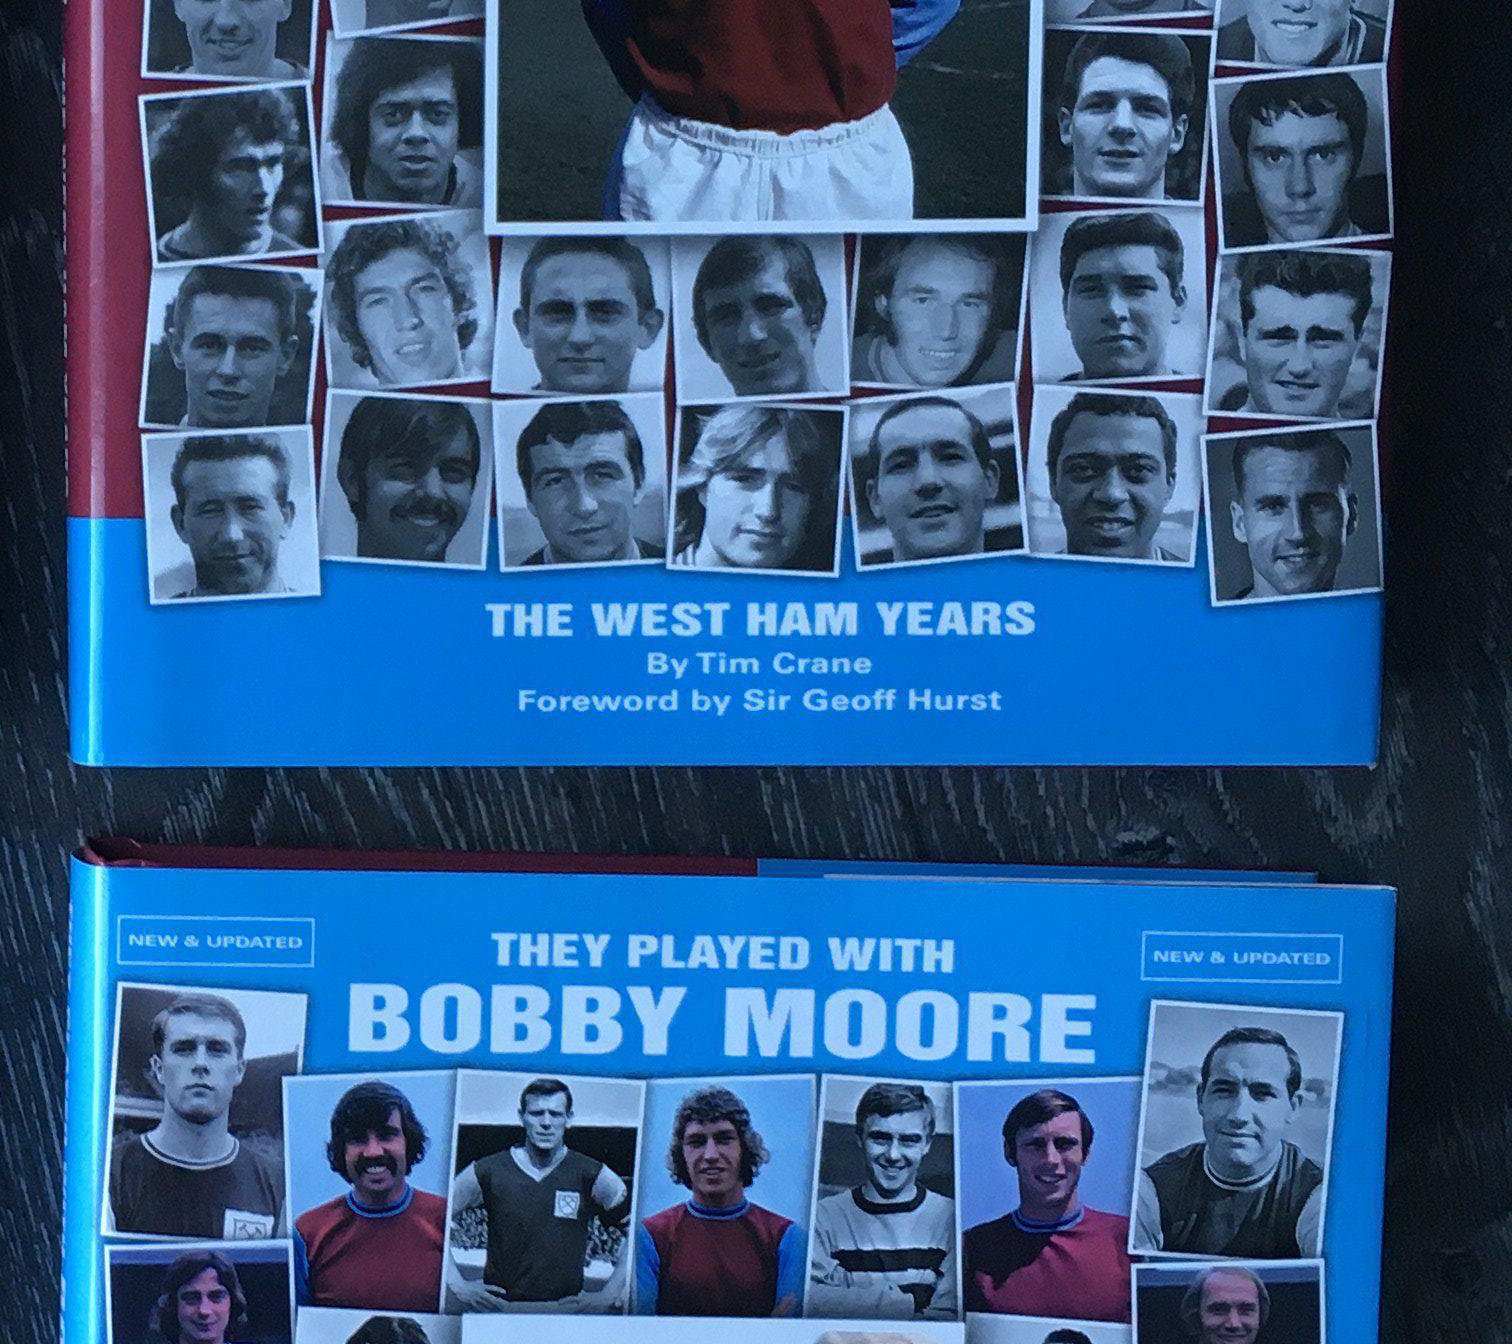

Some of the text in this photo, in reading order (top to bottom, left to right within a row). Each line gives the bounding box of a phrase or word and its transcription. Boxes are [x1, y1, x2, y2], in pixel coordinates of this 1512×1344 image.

[485, 600, 1036, 637] THE WEST HAM YEARS
[647, 651, 873, 680] By Tim Crane
[518, 688, 1002, 717] Foreword by Sir Geoff Hurst
[128, 933, 303, 950] NEW & UPDATED
[491, 932, 955, 974] THEY PLAYED WITH
[1153, 950, 1332, 966] NEW & UPDATED
[348, 982, 1097, 1065] BOBBY MOORE
